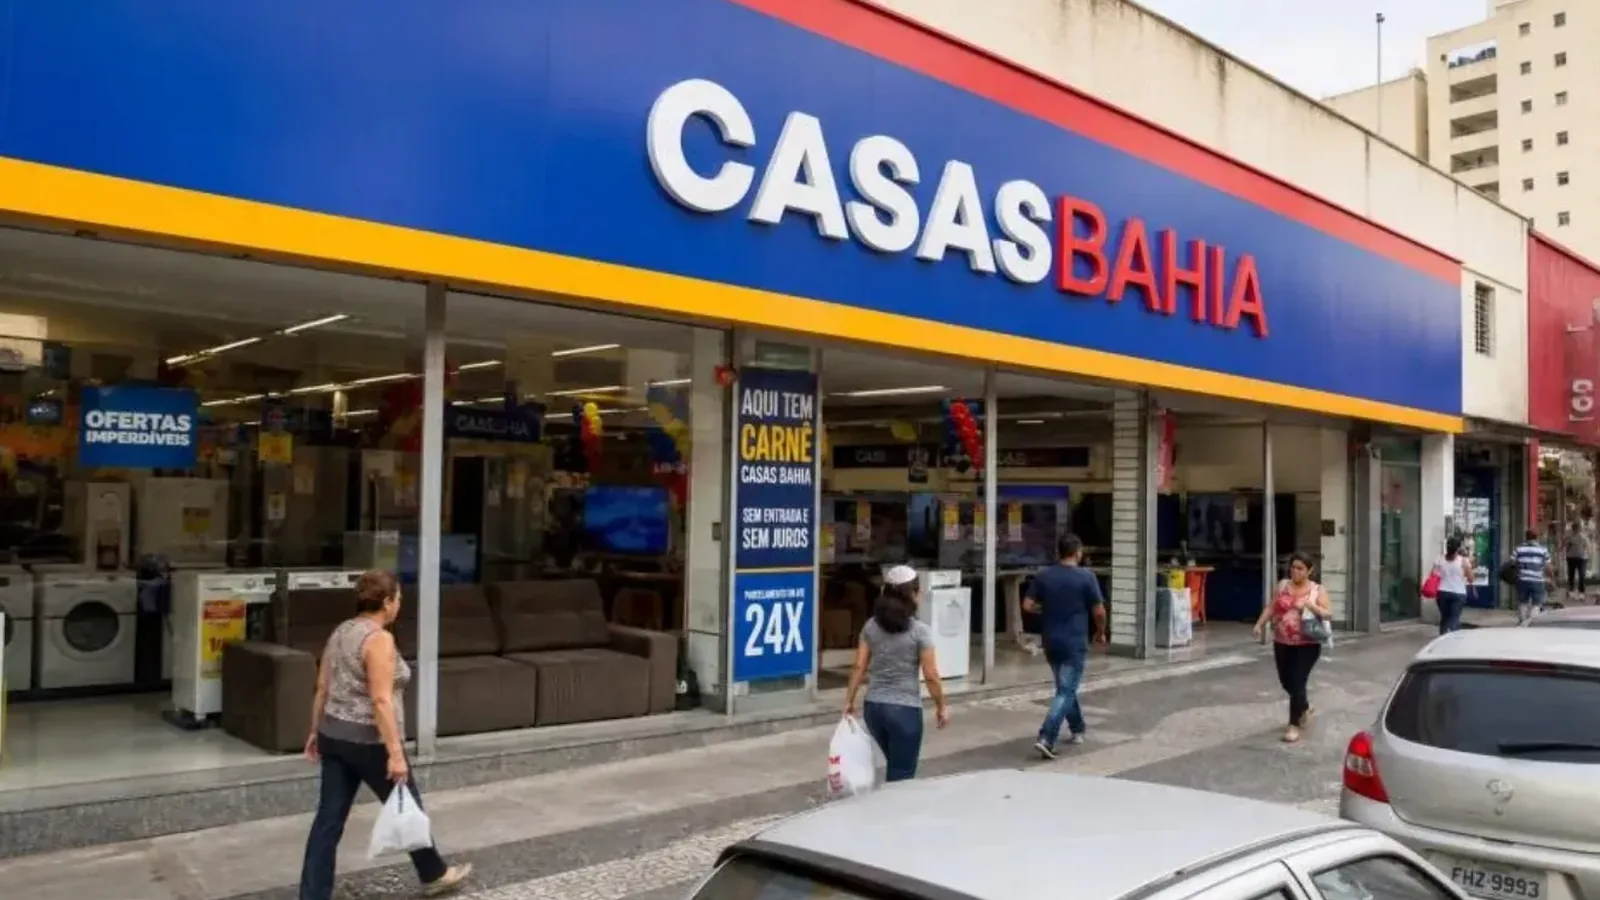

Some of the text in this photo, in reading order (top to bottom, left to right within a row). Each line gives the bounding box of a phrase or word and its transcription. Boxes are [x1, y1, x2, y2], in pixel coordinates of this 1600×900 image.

[647, 79, 1269, 338] CASAS BAHIA
[742, 388, 813, 419] AQUI TEM
[85, 410, 191, 431] OFERTAS
[86, 430, 190, 446] IMPERDÍVEIS
[741, 421, 812, 462] CARNÊ
[741, 465, 812, 485] CASAS BAHIA
[742, 507, 809, 523] SEM ENTRADA E
[742, 527, 809, 549] SEM JUROS
[744, 601, 804, 656] 24X
